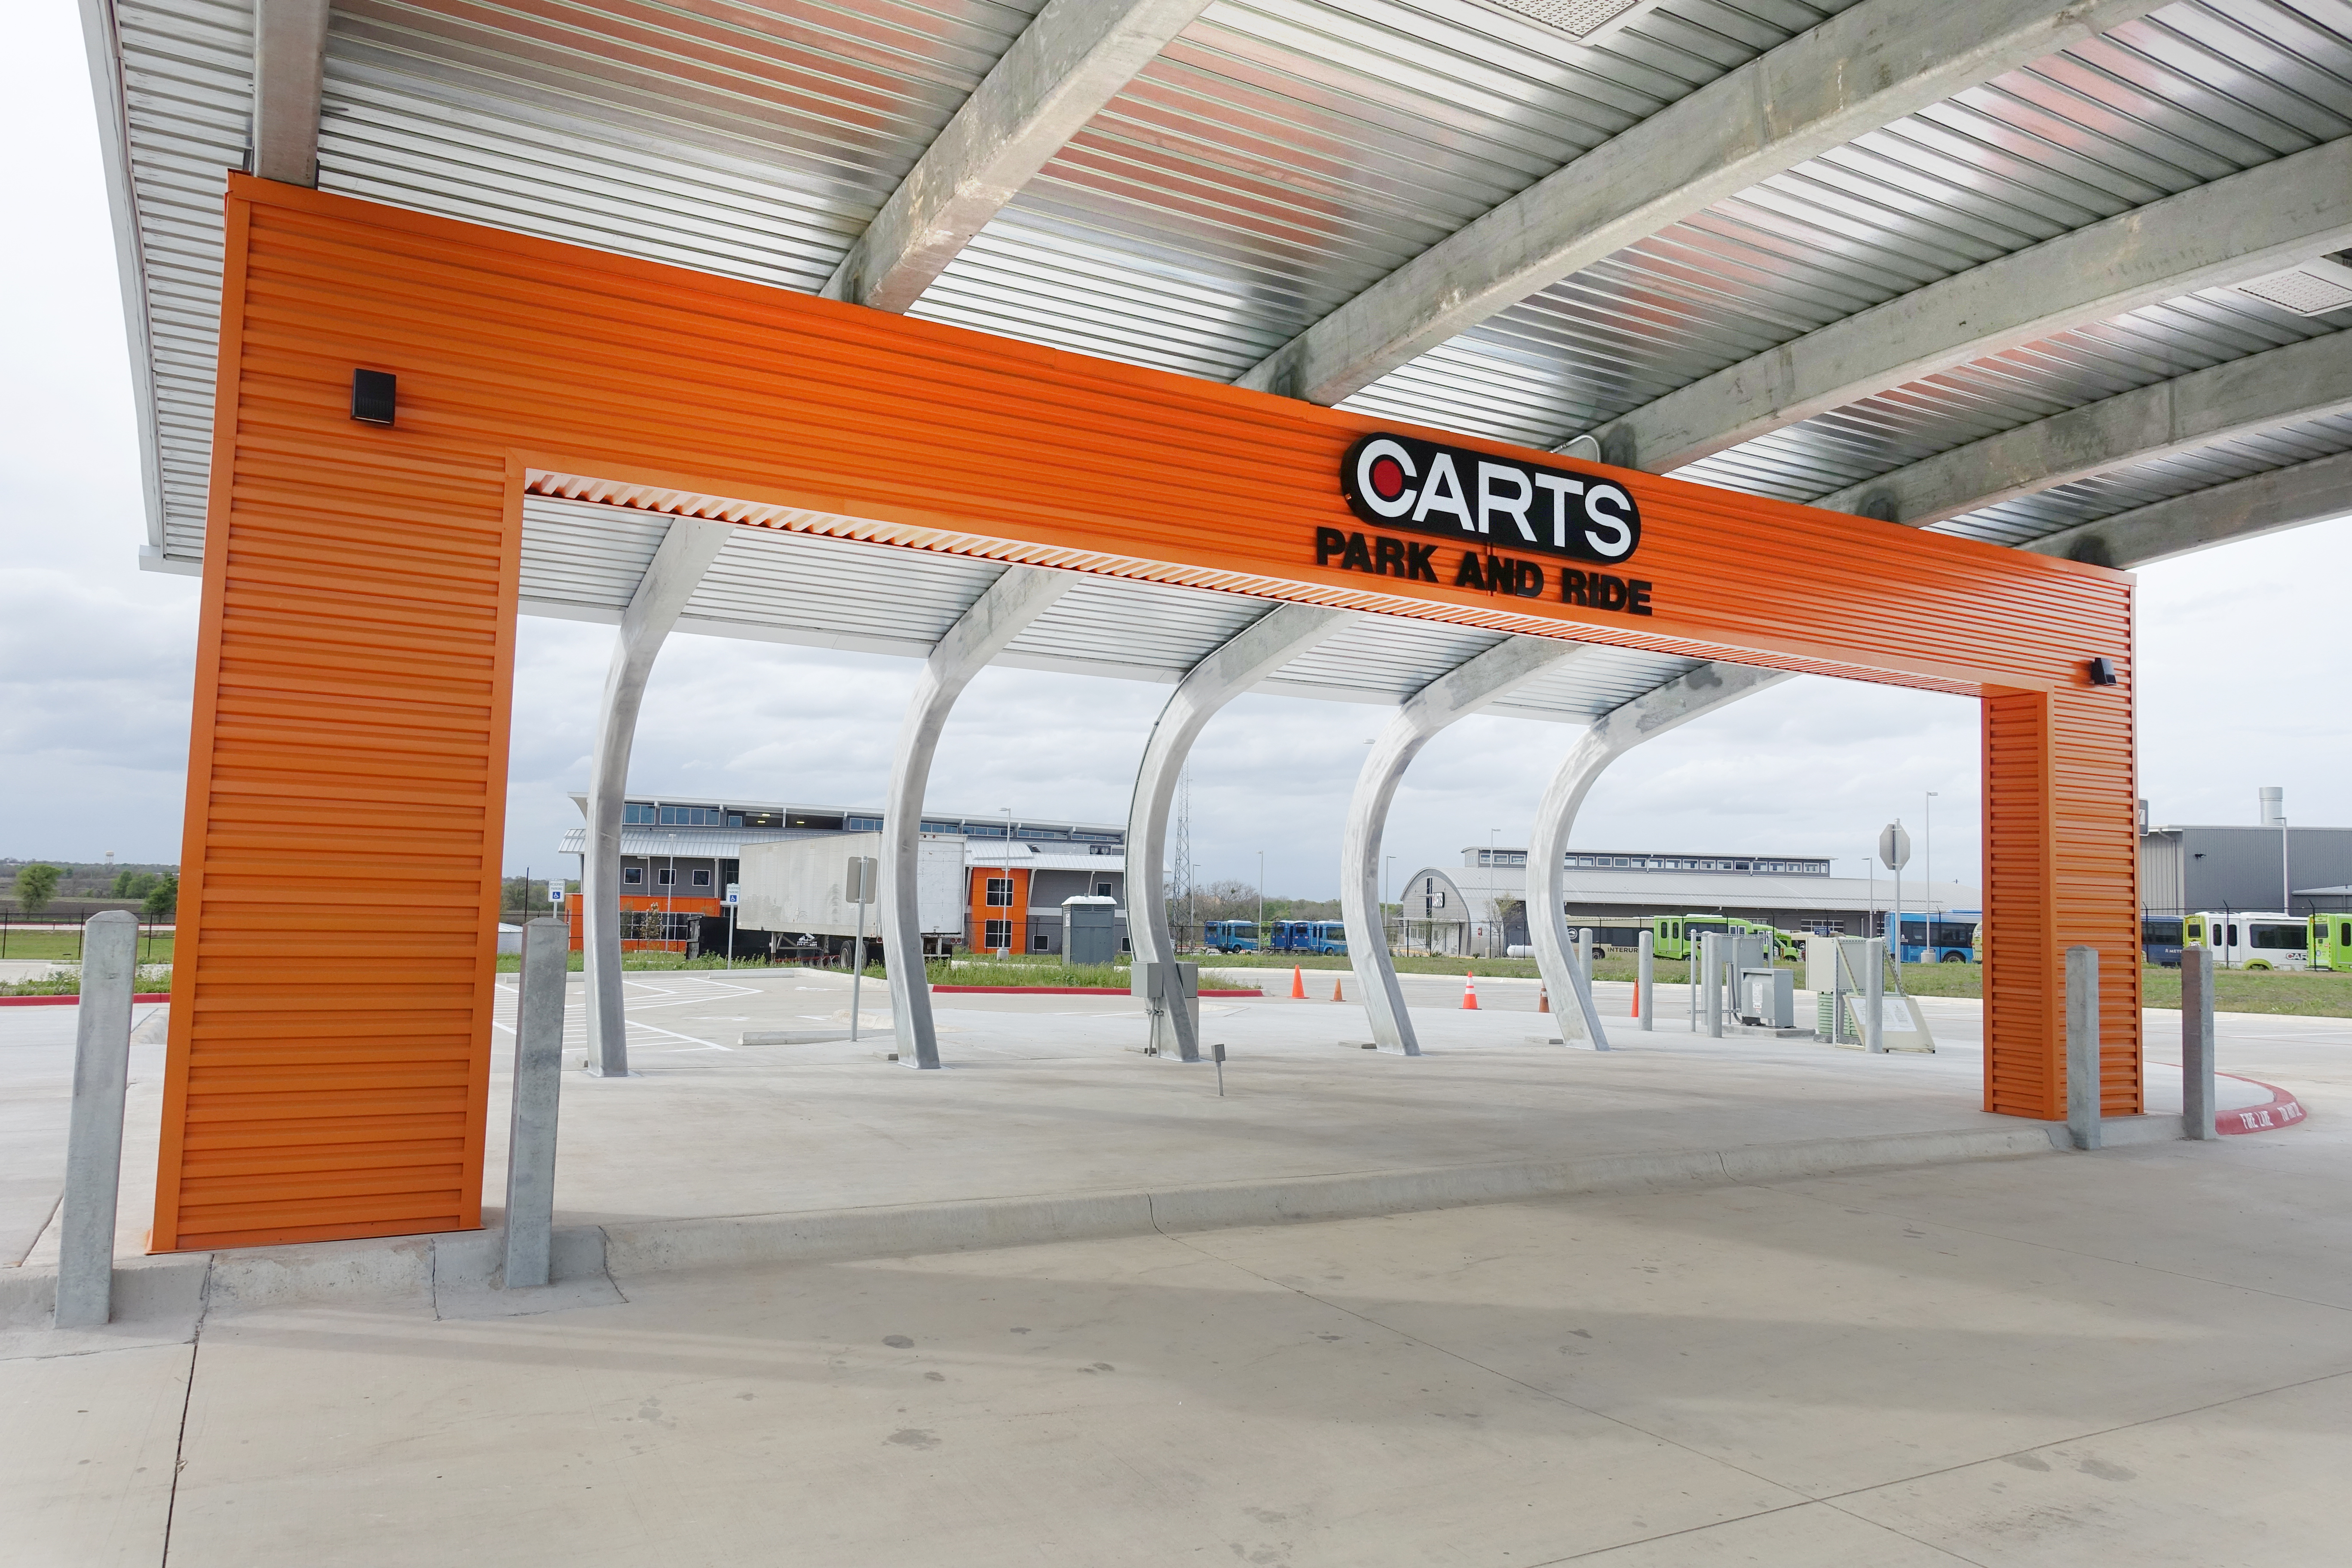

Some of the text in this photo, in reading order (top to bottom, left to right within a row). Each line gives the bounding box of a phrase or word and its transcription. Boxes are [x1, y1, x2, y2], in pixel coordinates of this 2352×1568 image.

[1357, 439, 1632, 557] CARTS
[1317, 526, 1652, 616] PARK AND RIDE
[1432, 892, 1443, 906] CARTS
[2239, 1112, 2259, 1129] FIRE
[2254, 1111, 2274, 1127] LANE
